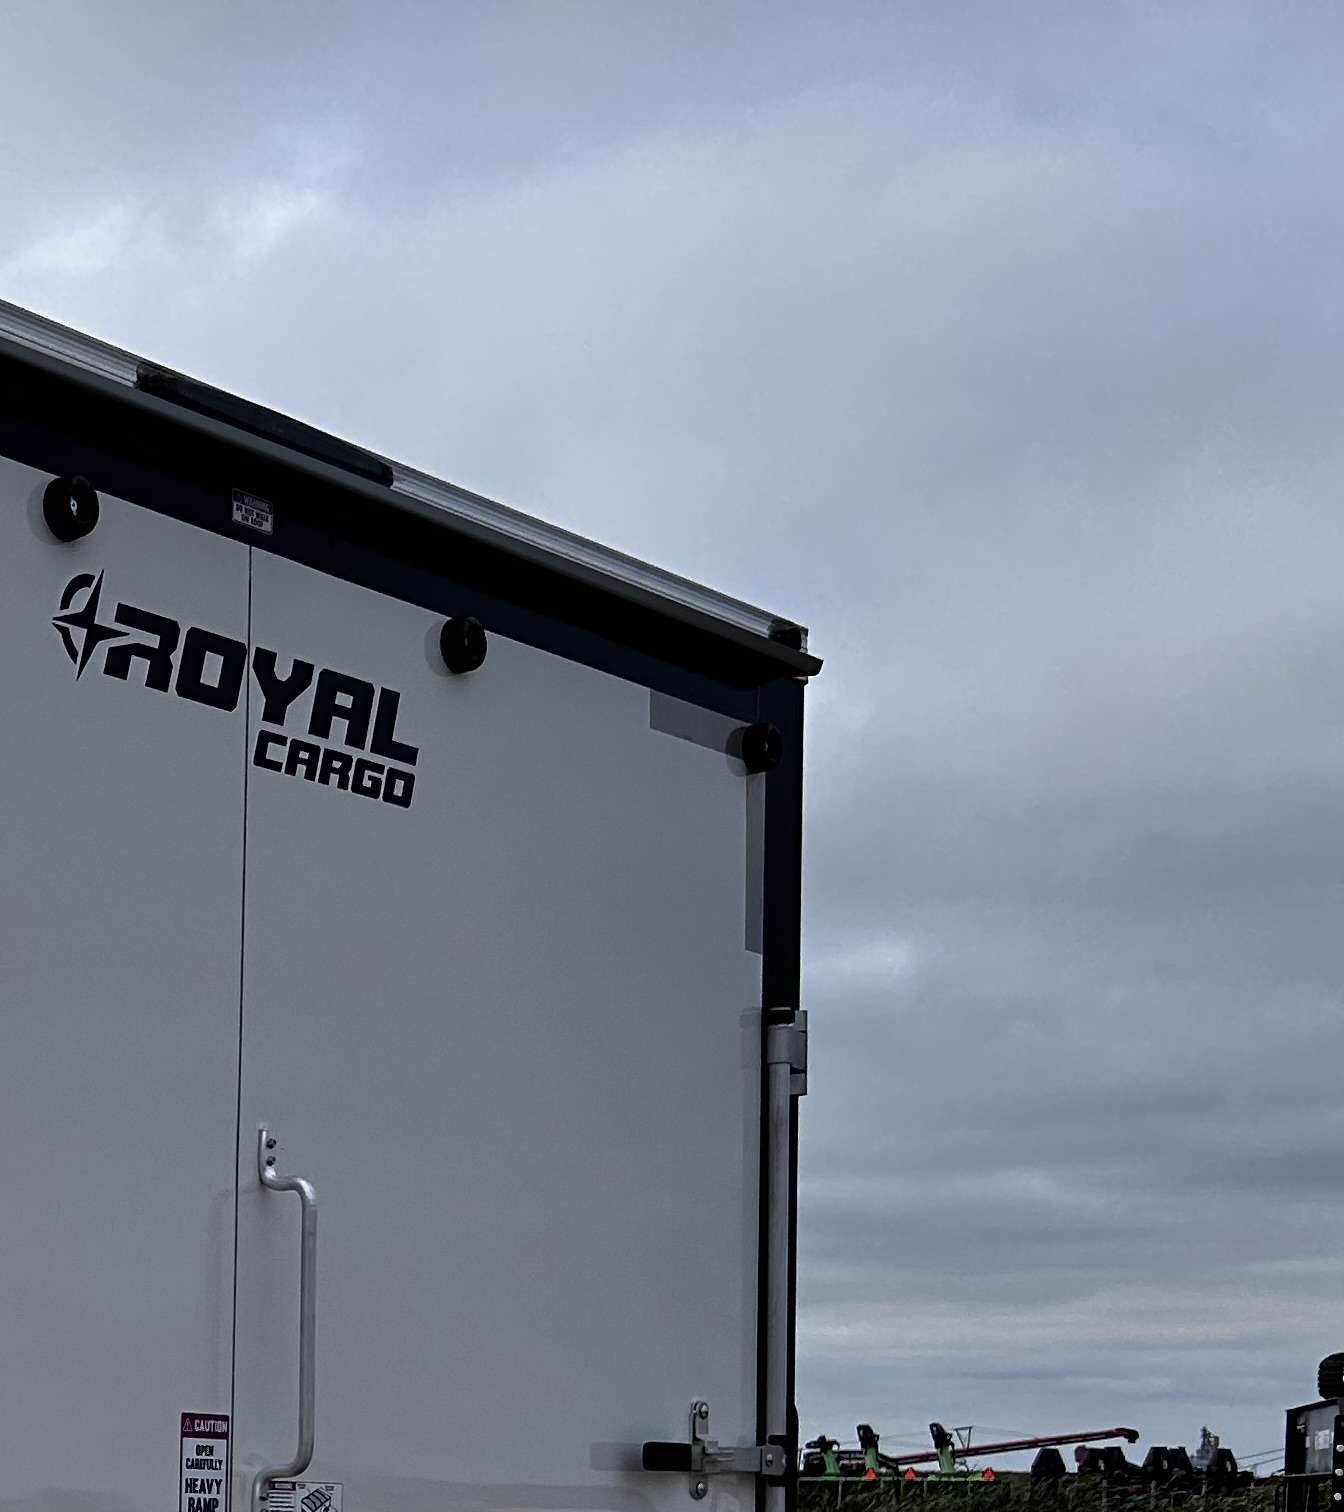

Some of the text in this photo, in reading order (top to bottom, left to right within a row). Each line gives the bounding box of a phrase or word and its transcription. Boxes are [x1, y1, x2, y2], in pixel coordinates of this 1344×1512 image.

[103, 602, 419, 766] ROYAL
[253, 730, 415, 809] CARGO
[194, 1419, 228, 1433] CAUTION
[196, 1444, 214, 1456] OPEN
[185, 1458, 223, 1470] CAREFULLY
[185, 1478, 223, 1494] HEAVY
[188, 1497, 219, 1512] RAMP
